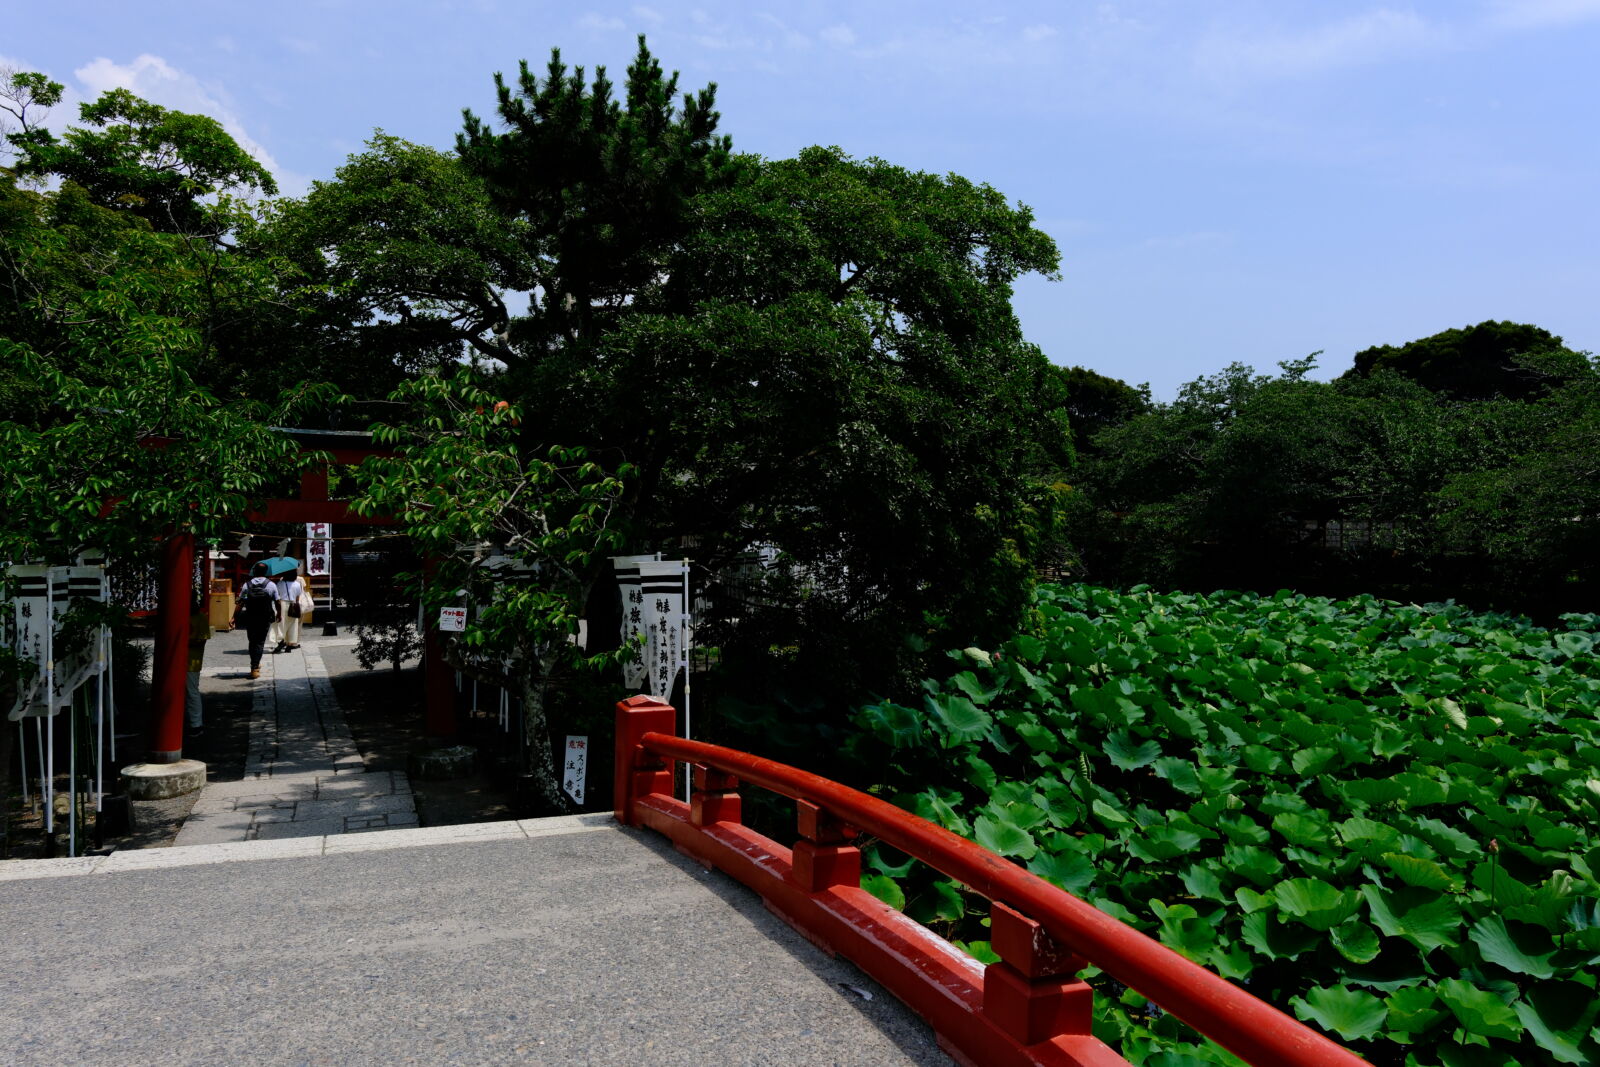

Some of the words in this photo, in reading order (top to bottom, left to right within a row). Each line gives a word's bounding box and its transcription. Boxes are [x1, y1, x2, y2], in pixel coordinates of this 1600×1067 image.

[310, 522, 326, 573] 七福神
[568, 740, 586, 749] 危険
[565, 760, 576, 791] 注意
